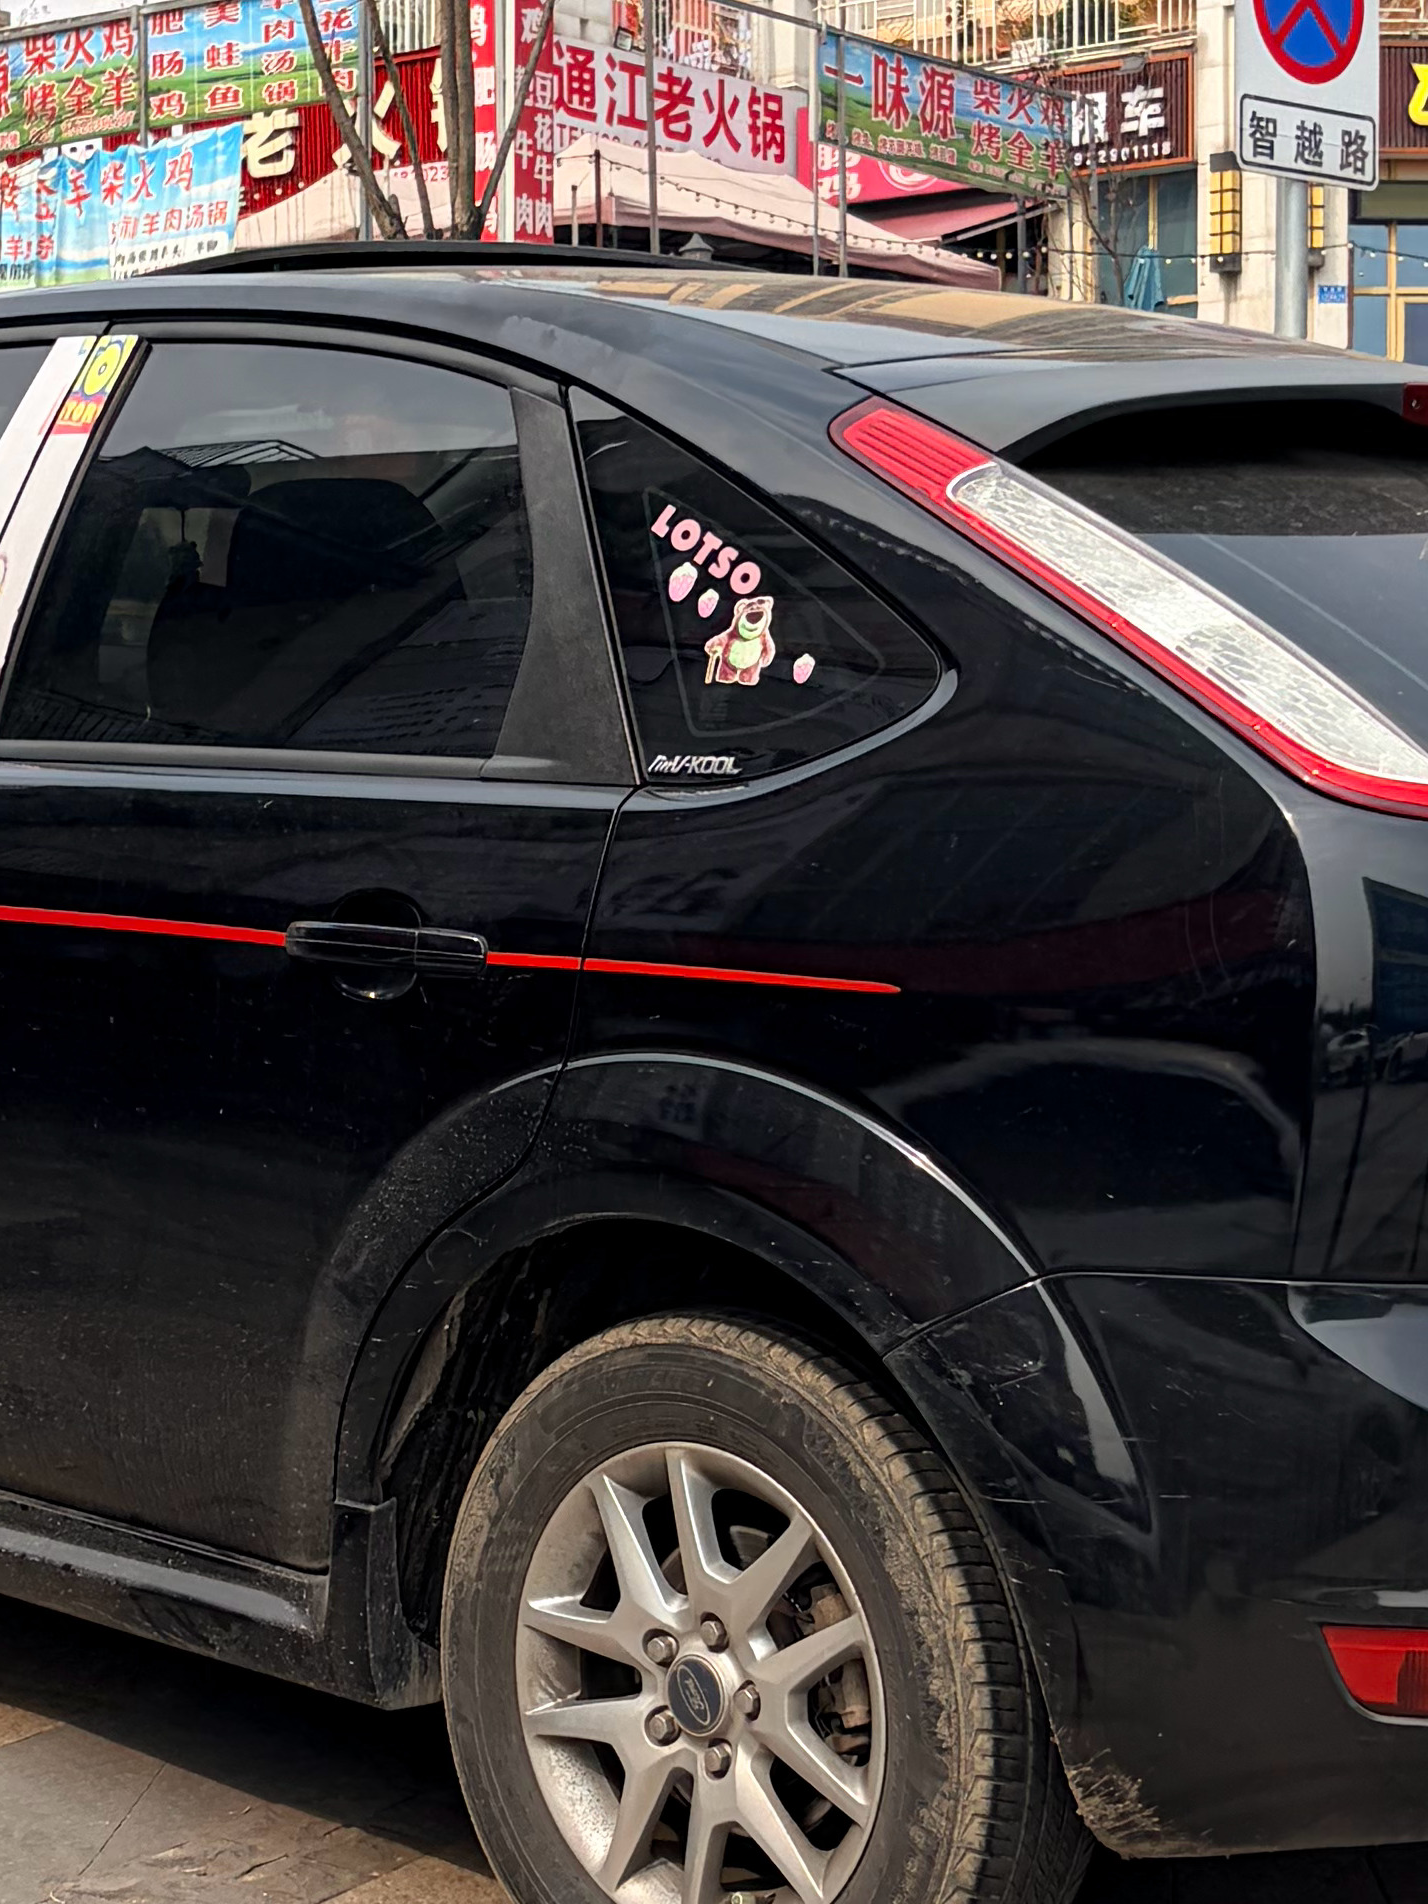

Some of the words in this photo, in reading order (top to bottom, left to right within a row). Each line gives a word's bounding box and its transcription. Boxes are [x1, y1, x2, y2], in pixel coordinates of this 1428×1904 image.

[24, 19, 139, 78] 柴火鸡
[149, 9, 188, 120] 肥肠鸡
[204, 0, 245, 114] 美蛙鱼
[24, 66, 138, 129] 烤全羊
[554, 40, 786, 164] 通江老火锅
[825, 52, 958, 141] 一味源
[972, 78, 1066, 127] 柴火鸡
[1249, 110, 1370, 176] 智越路
[651, 504, 761, 595] LOTSO
